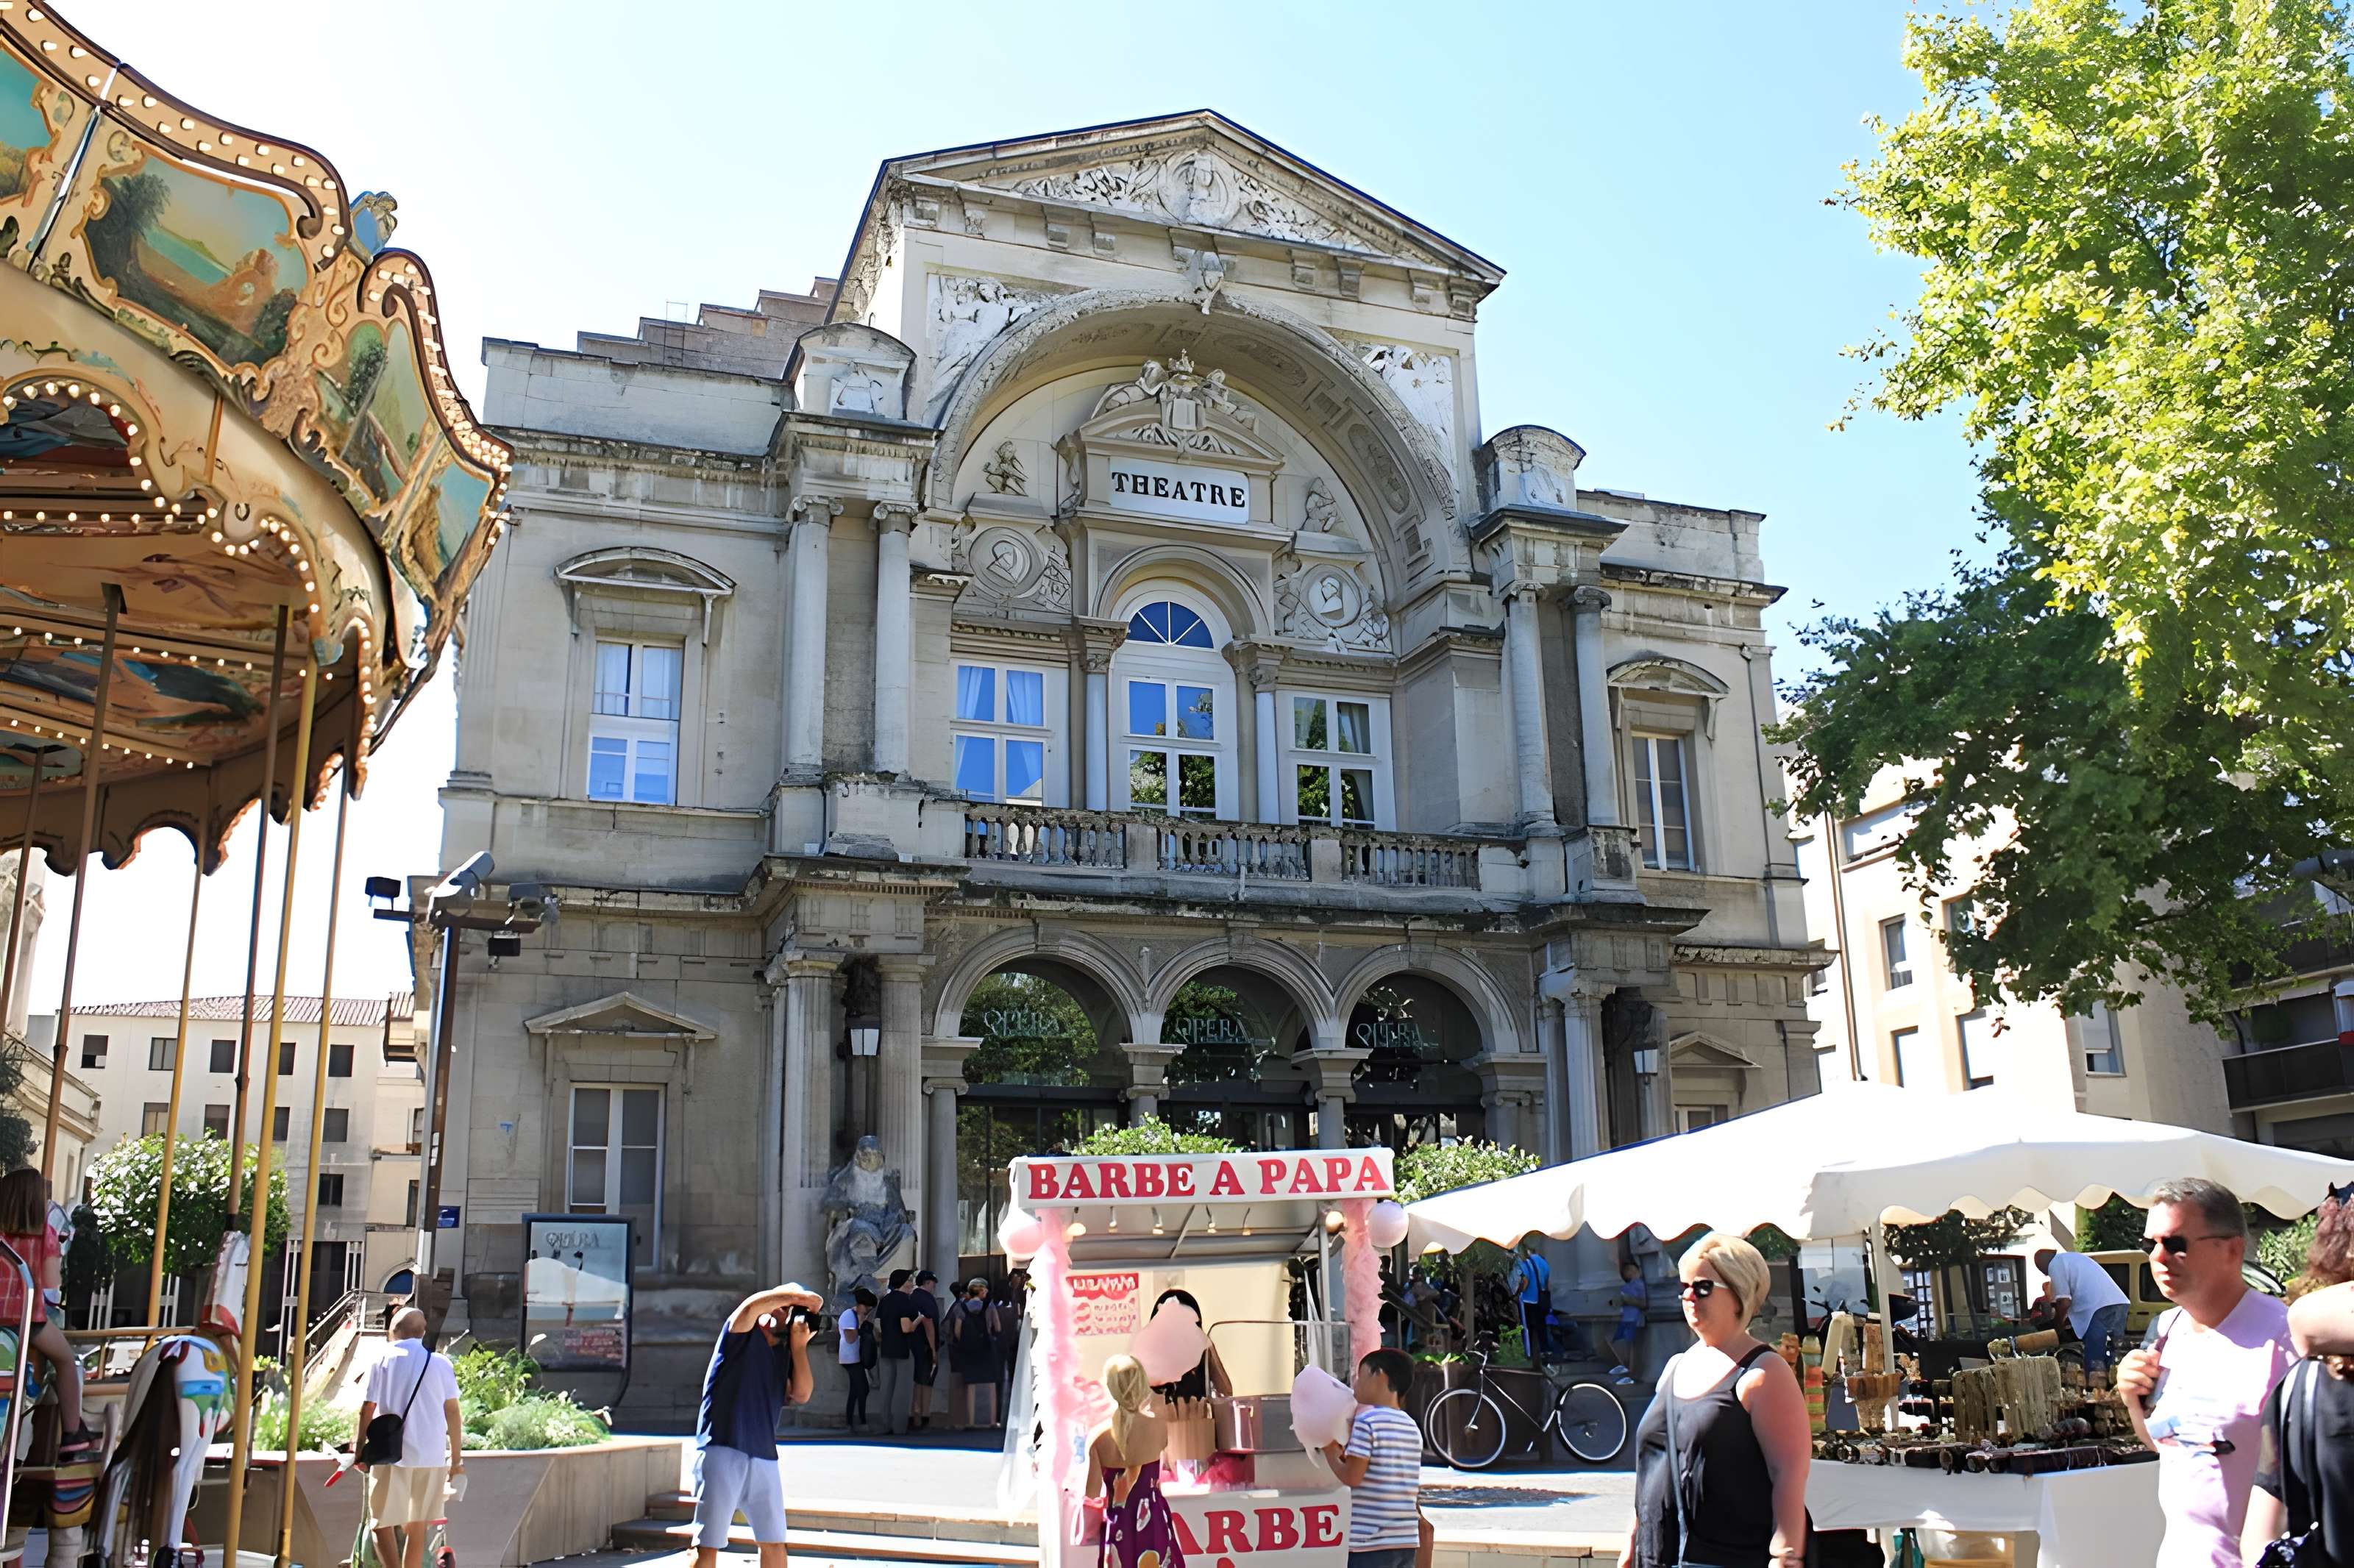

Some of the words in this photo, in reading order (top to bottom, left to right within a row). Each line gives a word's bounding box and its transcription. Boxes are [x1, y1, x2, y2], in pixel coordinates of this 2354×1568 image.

[1112, 471, 1245, 508] THEATRE
[1028, 1163, 1195, 1200] BARBE
[1209, 1161, 1245, 1196] A
[1257, 1156, 1389, 1194] PAPA
[1171, 1504, 1343, 1555] ARBE
